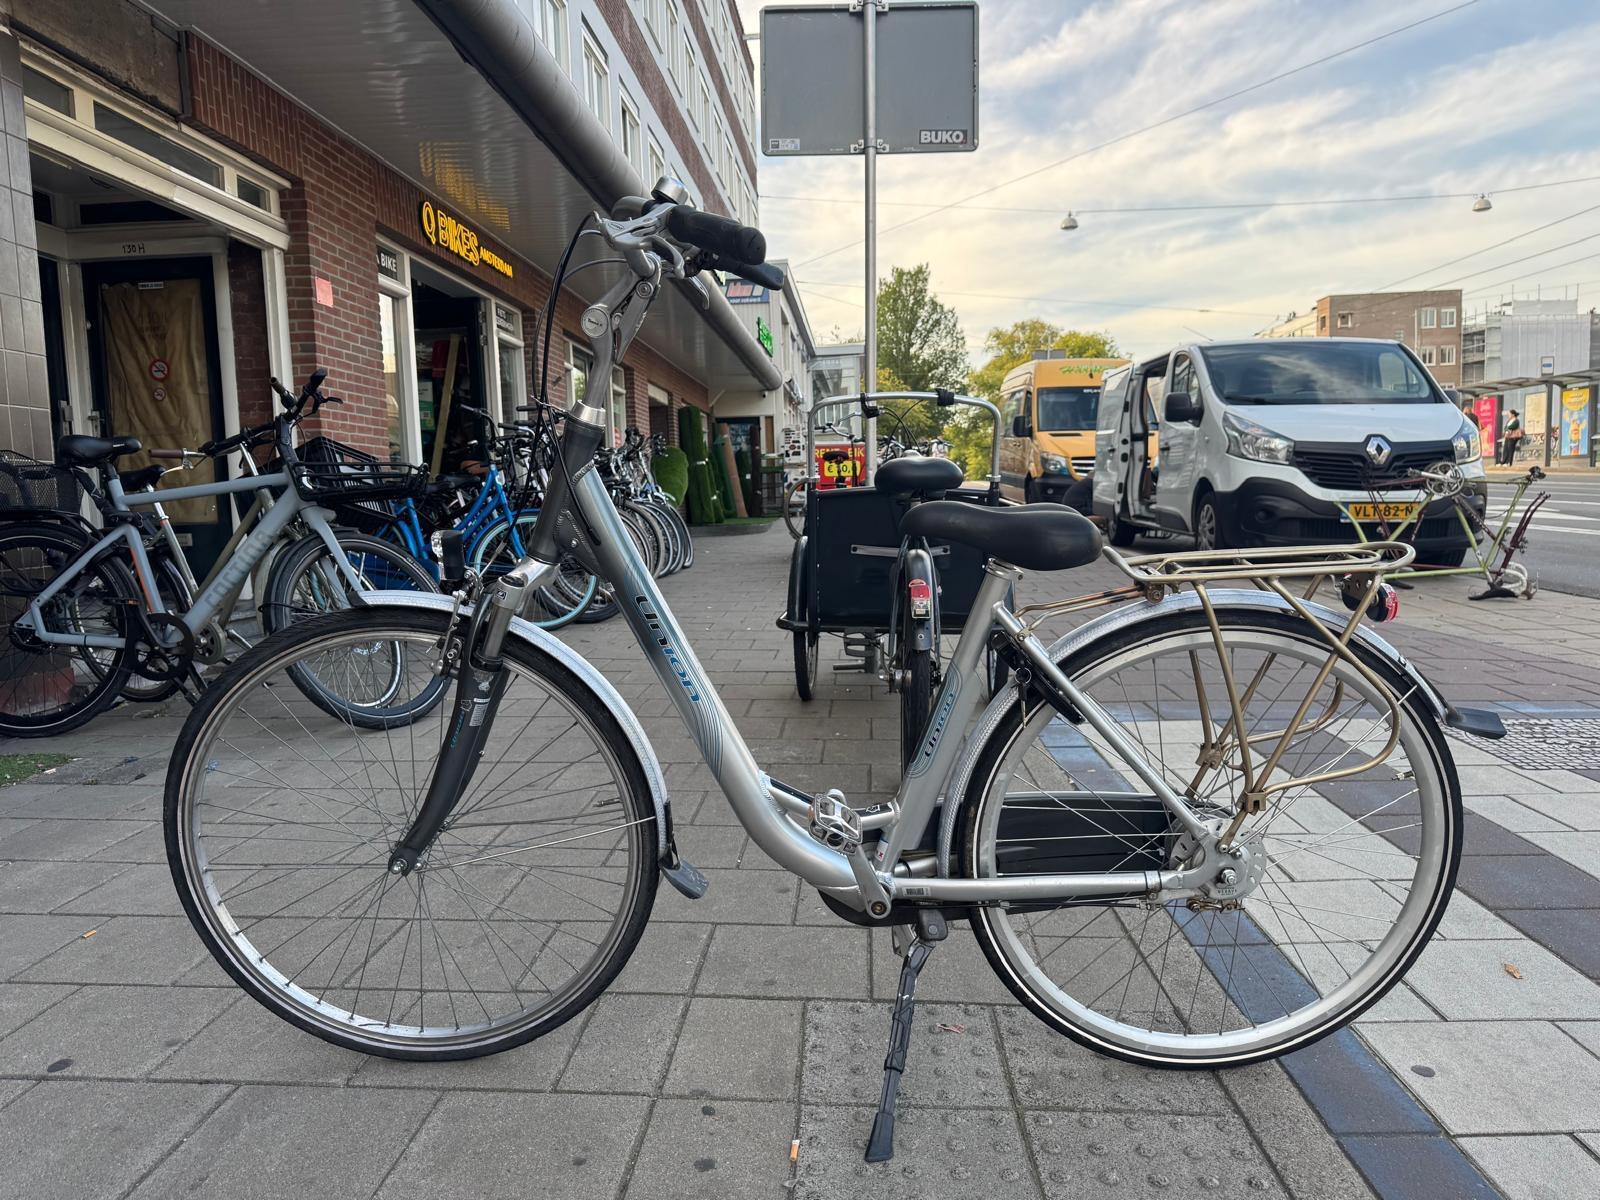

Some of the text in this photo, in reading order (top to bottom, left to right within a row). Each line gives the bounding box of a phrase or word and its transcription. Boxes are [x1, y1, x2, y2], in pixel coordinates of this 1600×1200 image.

[122, 242, 146, 255] 130 H
[422, 201, 513, 278] Q BIKES AMSTERDAM
[380, 252, 397, 272] BIKE
